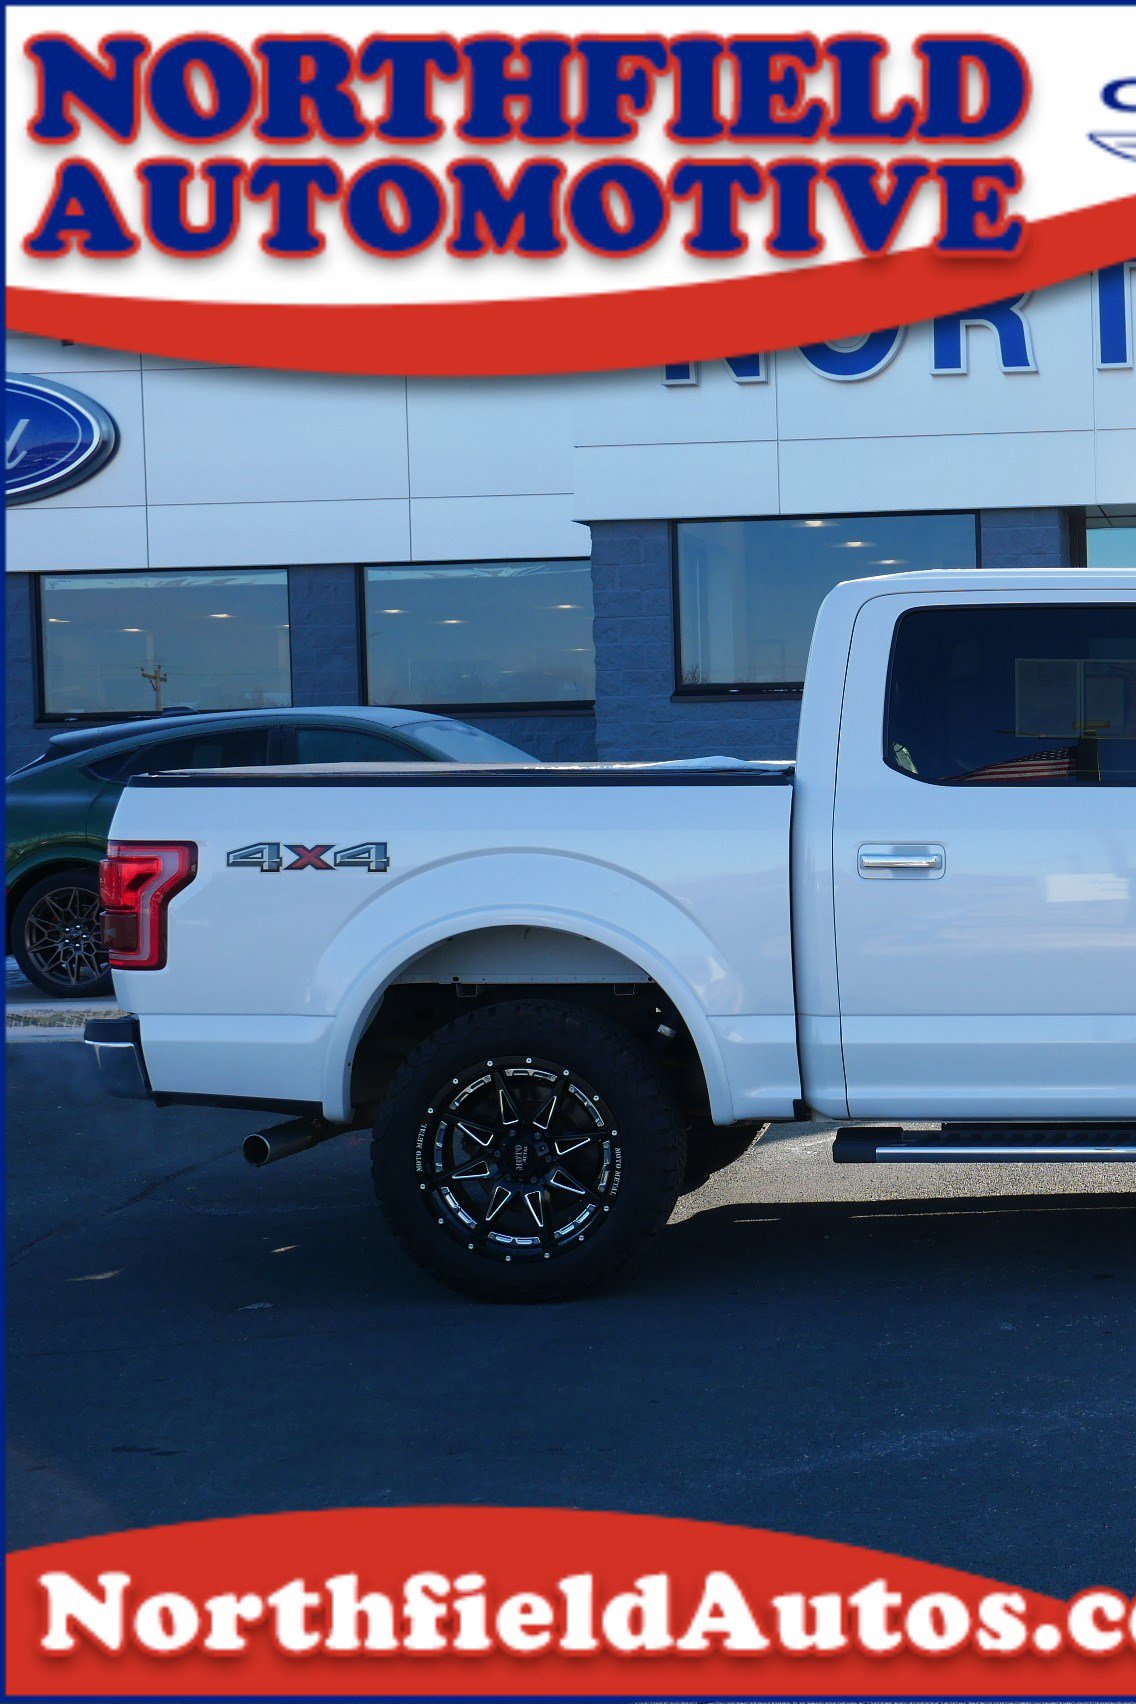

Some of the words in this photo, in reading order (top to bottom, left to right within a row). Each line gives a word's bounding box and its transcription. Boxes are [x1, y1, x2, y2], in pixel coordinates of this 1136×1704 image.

[415, 1123, 428, 1149] METAL
[415, 1150, 423, 1172] MOTO
[614, 1147, 622, 1169] MOTO
[610, 1170, 621, 1196] METAL
